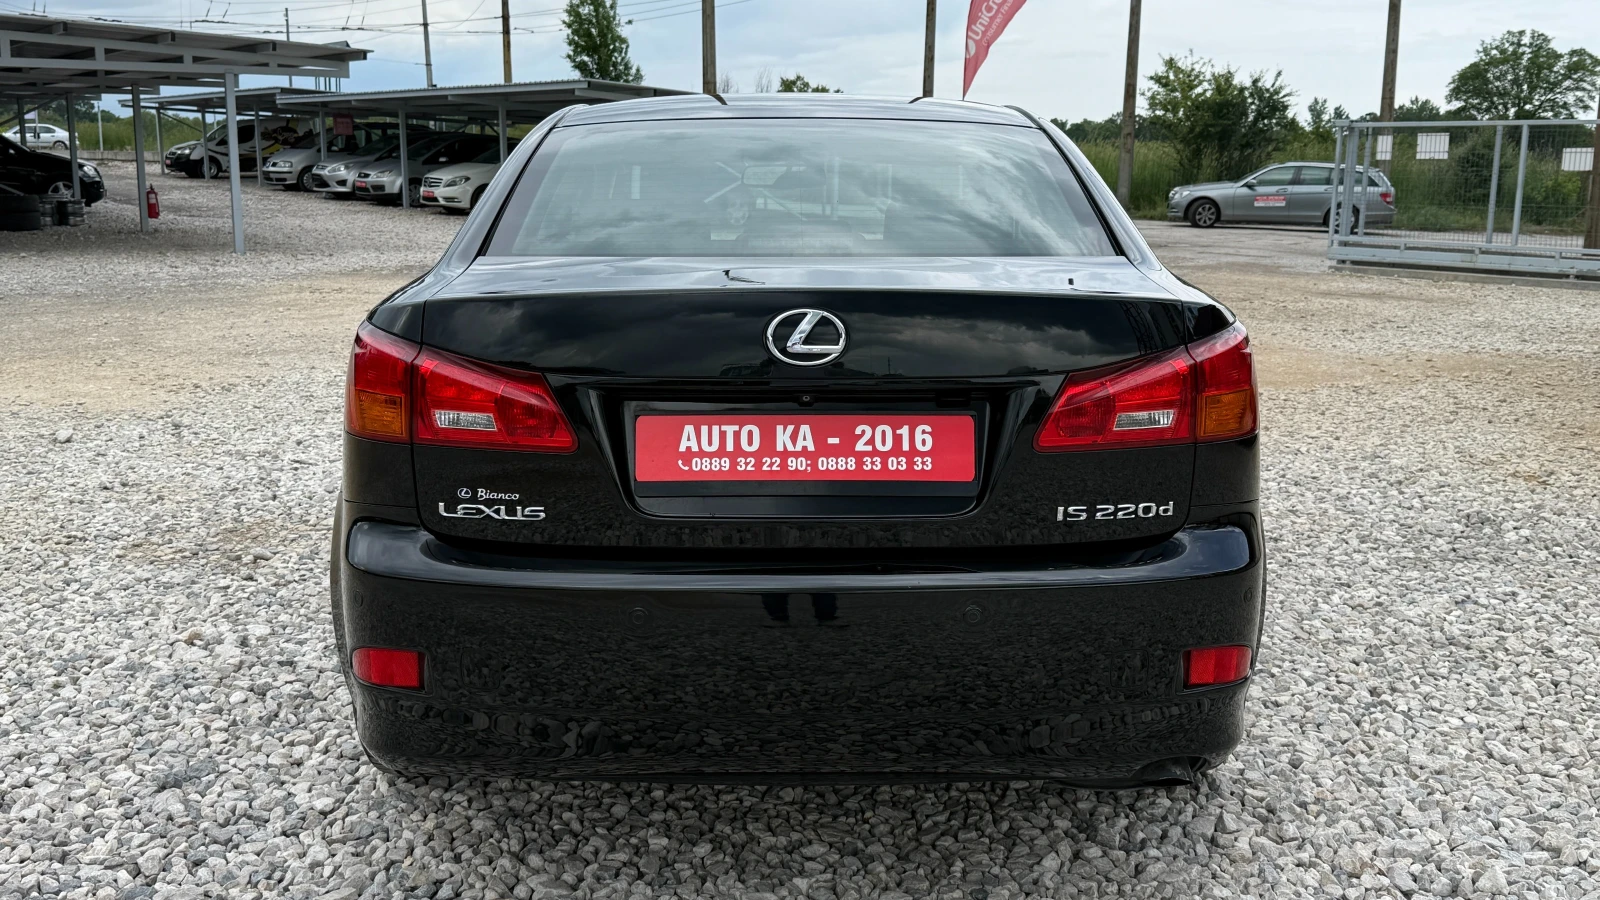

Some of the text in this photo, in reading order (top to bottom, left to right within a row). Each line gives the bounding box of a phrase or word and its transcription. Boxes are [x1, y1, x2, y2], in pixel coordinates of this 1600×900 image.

[678, 424, 760, 452] AUTO
[776, 424, 815, 452] KA
[854, 424, 933, 452] 2016
[692, 457, 932, 473] 0889 32 22 90; 0888 33 03 33
[477, 488, 520, 500] Bianco
[438, 502, 546, 520] LEXUS
[1056, 501, 1174, 521] IS 220d
